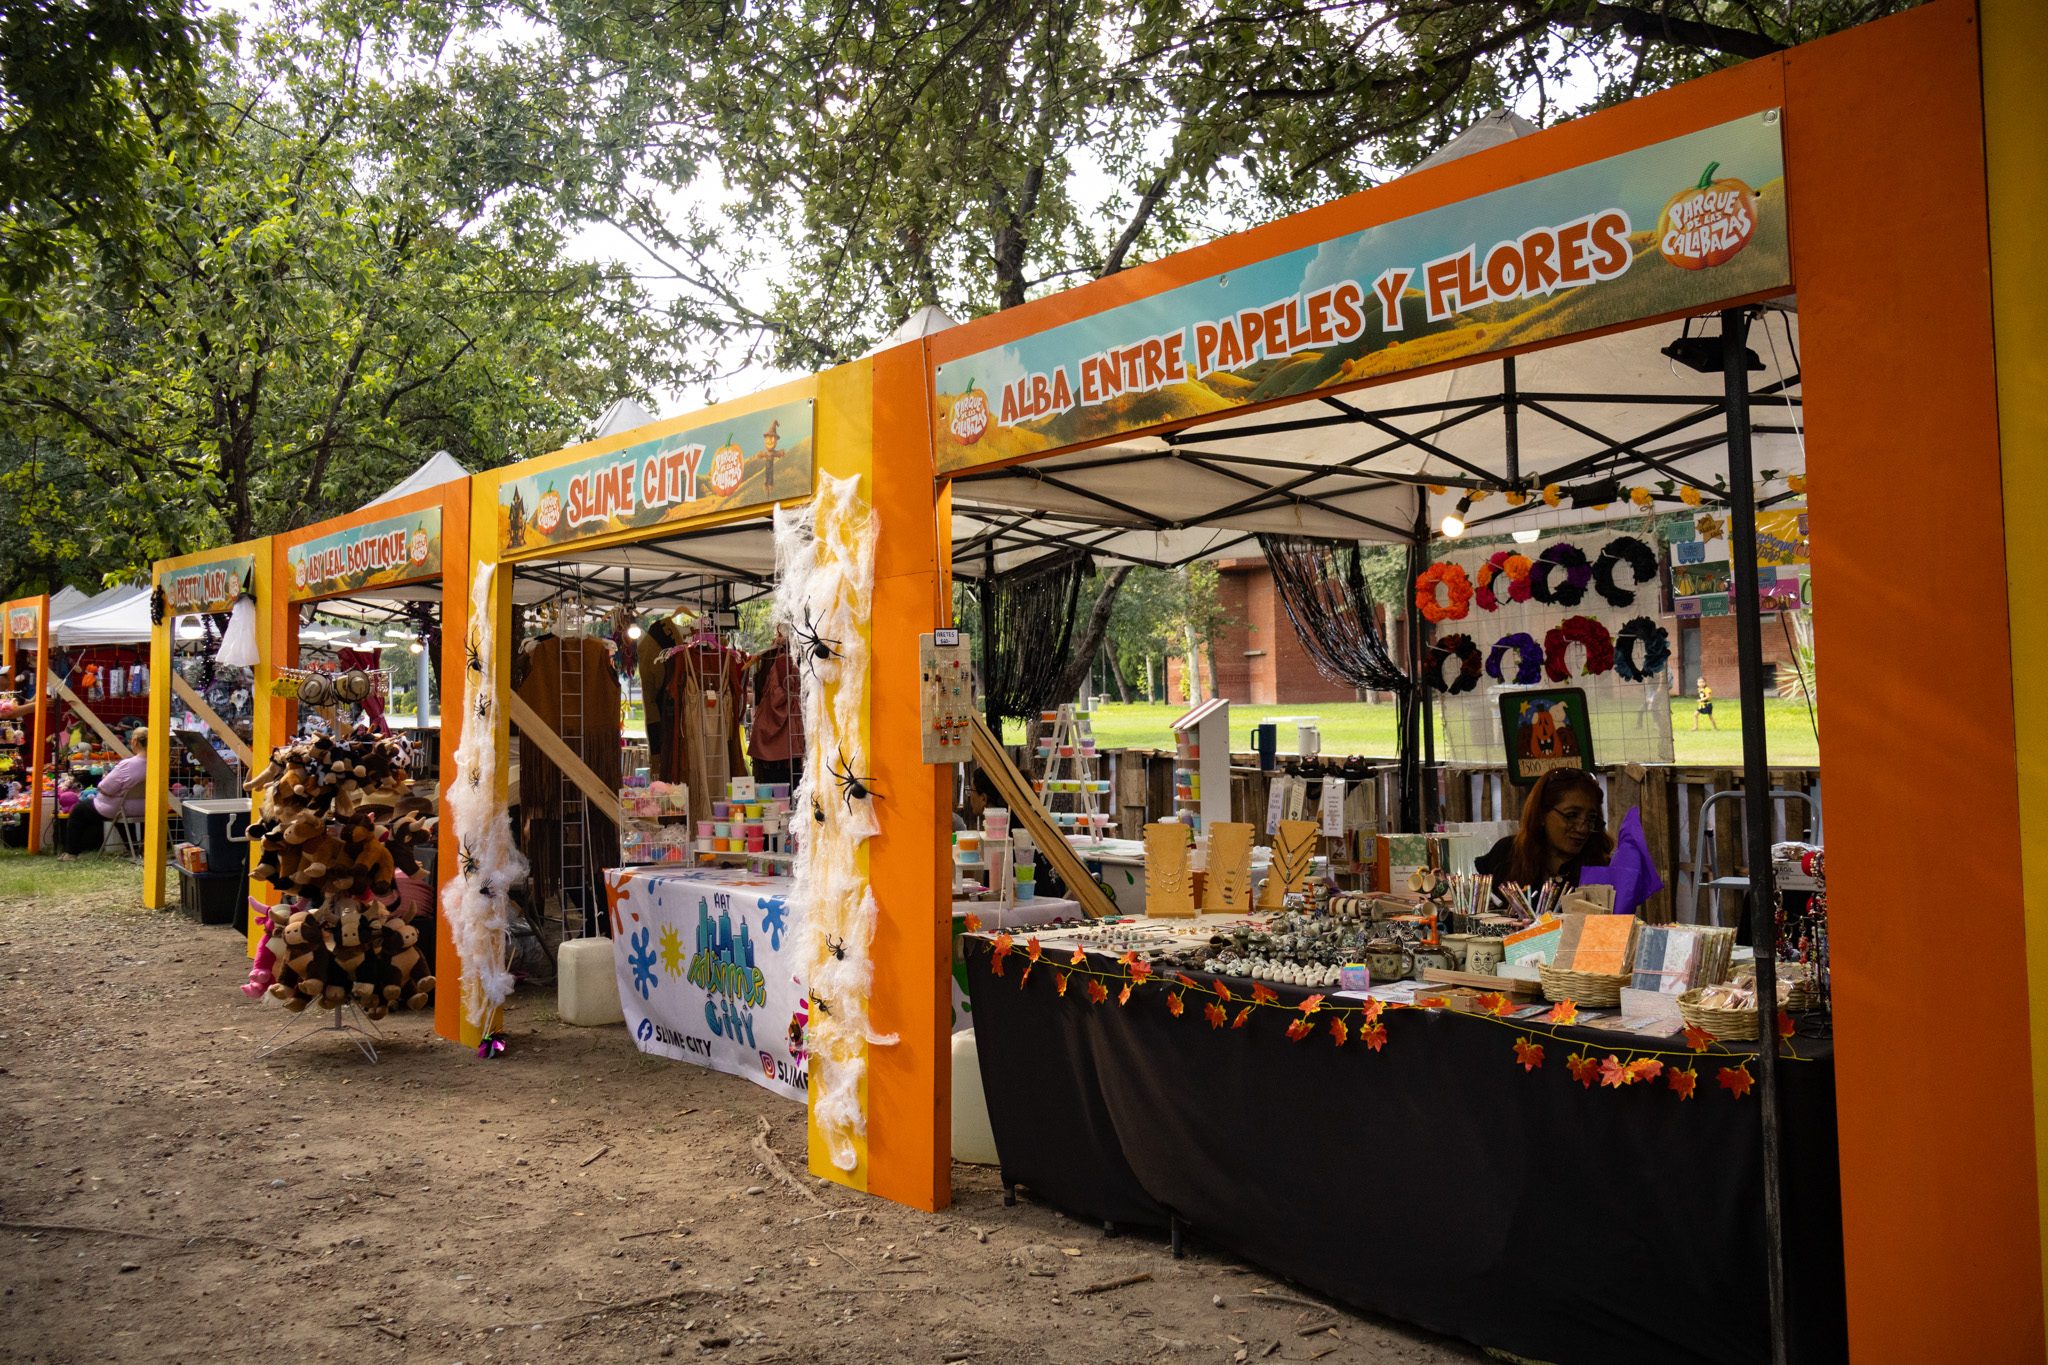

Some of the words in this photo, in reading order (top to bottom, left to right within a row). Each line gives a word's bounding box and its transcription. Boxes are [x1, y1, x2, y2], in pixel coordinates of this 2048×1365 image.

[1668, 191, 1740, 230] PARQUE
[1686, 217, 1702, 231] DE
[1704, 211, 1722, 225] LAS
[1661, 208, 1751, 258] CALABAZAS
[998, 370, 1075, 427] ALBA
[1079, 326, 1187, 406] ENTRE
[1194, 280, 1365, 380] PAPELES
[1372, 268, 1415, 332] Y
[1423, 207, 1633, 322] FLORES
[951, 408, 988, 438] CALABAZAS
[954, 396, 983, 419] PARQUE
[567, 459, 637, 527] SLIME
[641, 443, 706, 508] CITY
[308, 553, 323, 584] ABY
[324, 543, 346, 580] LEAL
[346, 528, 407, 575] BOUTIQUE
[176, 573, 202, 607] PRETTY
[203, 569, 227, 604] MARY
[655, 1025, 685, 1051] SLIME
[686, 1039, 712, 1057] CITY
